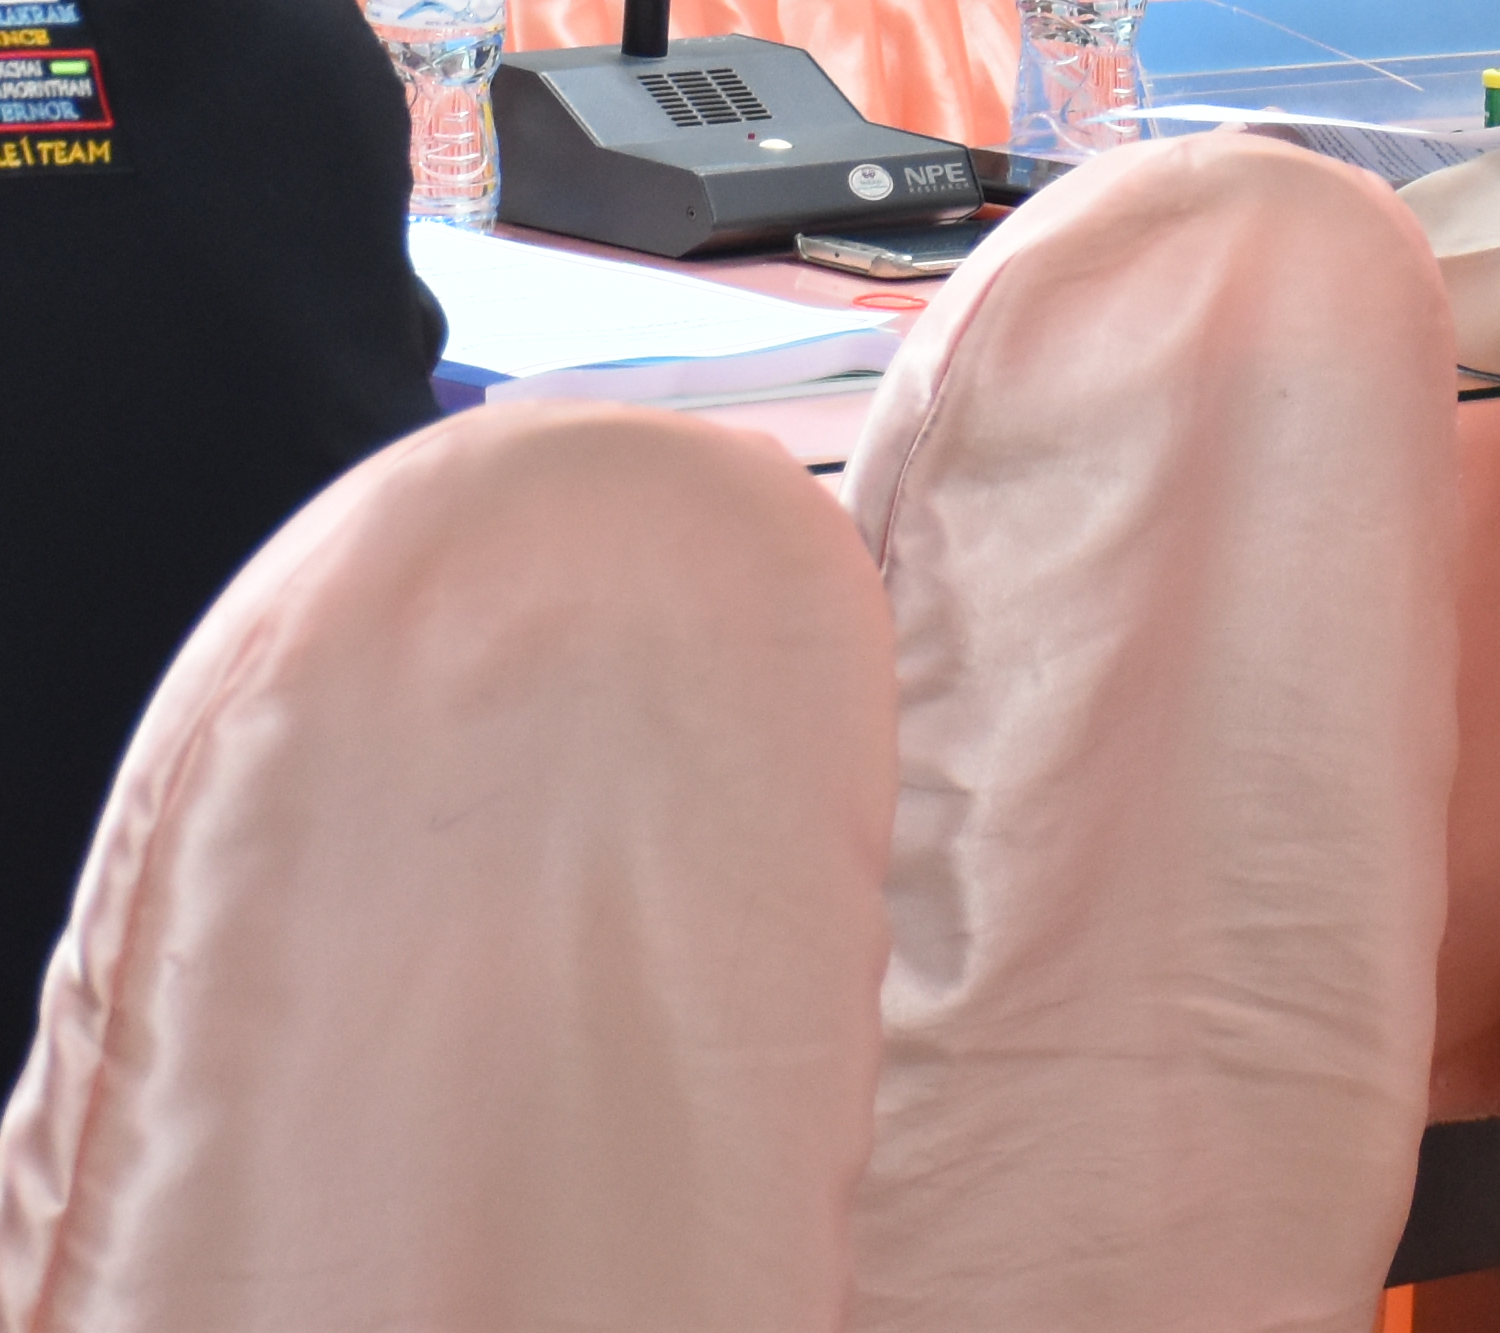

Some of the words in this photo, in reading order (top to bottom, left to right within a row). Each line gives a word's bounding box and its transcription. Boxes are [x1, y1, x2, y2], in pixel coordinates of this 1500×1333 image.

[36, 139, 111, 165] TEAM
[903, 162, 967, 187] NPE
[908, 182, 971, 194] RESEARCH
